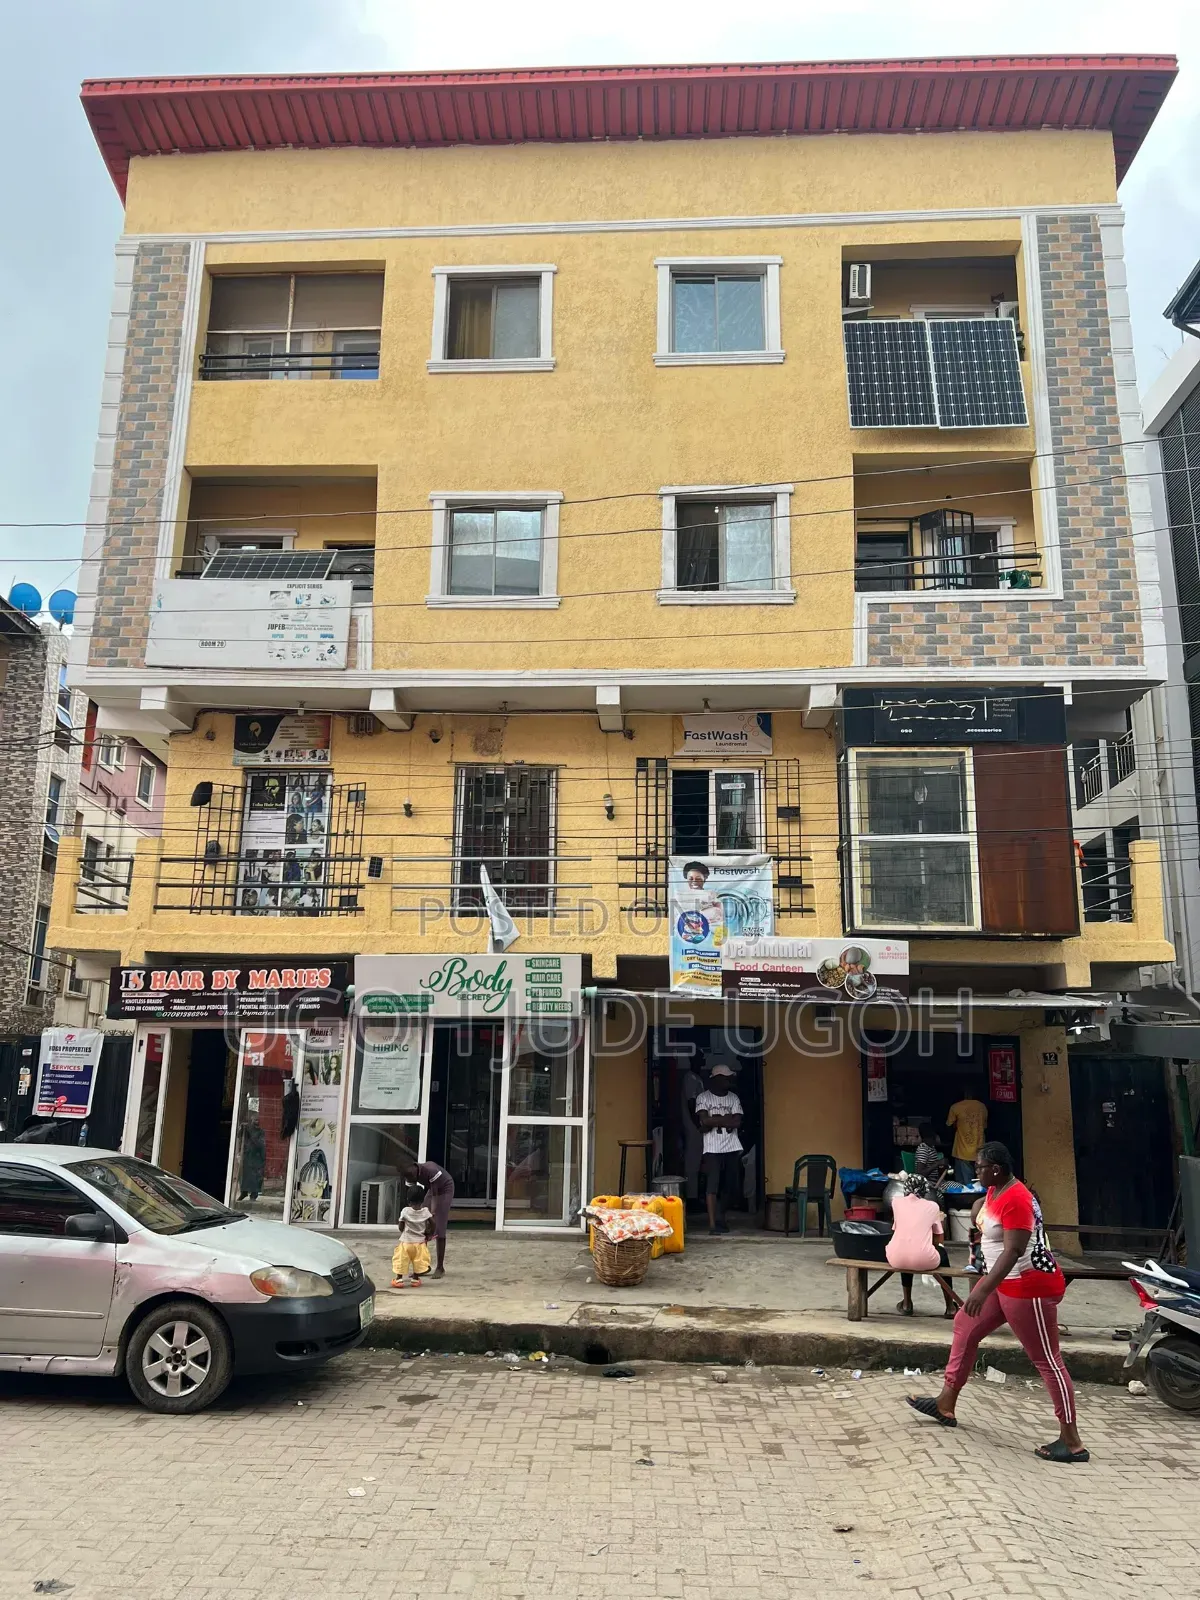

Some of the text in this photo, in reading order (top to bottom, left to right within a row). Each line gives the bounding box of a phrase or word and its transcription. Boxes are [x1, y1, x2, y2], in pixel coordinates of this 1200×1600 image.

[684, 731, 748, 740] FastWash
[713, 866, 761, 875] FastWash
[531, 959, 560, 968] SKINCARE
[734, 962, 759, 972] Food
[762, 962, 804, 973] Canteen
[149, 970, 205, 991] HAIR
[211, 969, 240, 990] BY
[248, 968, 331, 989] MARIES
[531, 974, 561, 982] HAIR CARE
[420, 957, 513, 1013] Body
[457, 993, 491, 1001] SECRETS
[532, 989, 561, 997] PERFUMES
[532, 1003, 572, 1011] BEAUTY NEEDS
[372, 1043, 409, 1052] HIRING
[1045, 1052, 1056, 1060] 12
